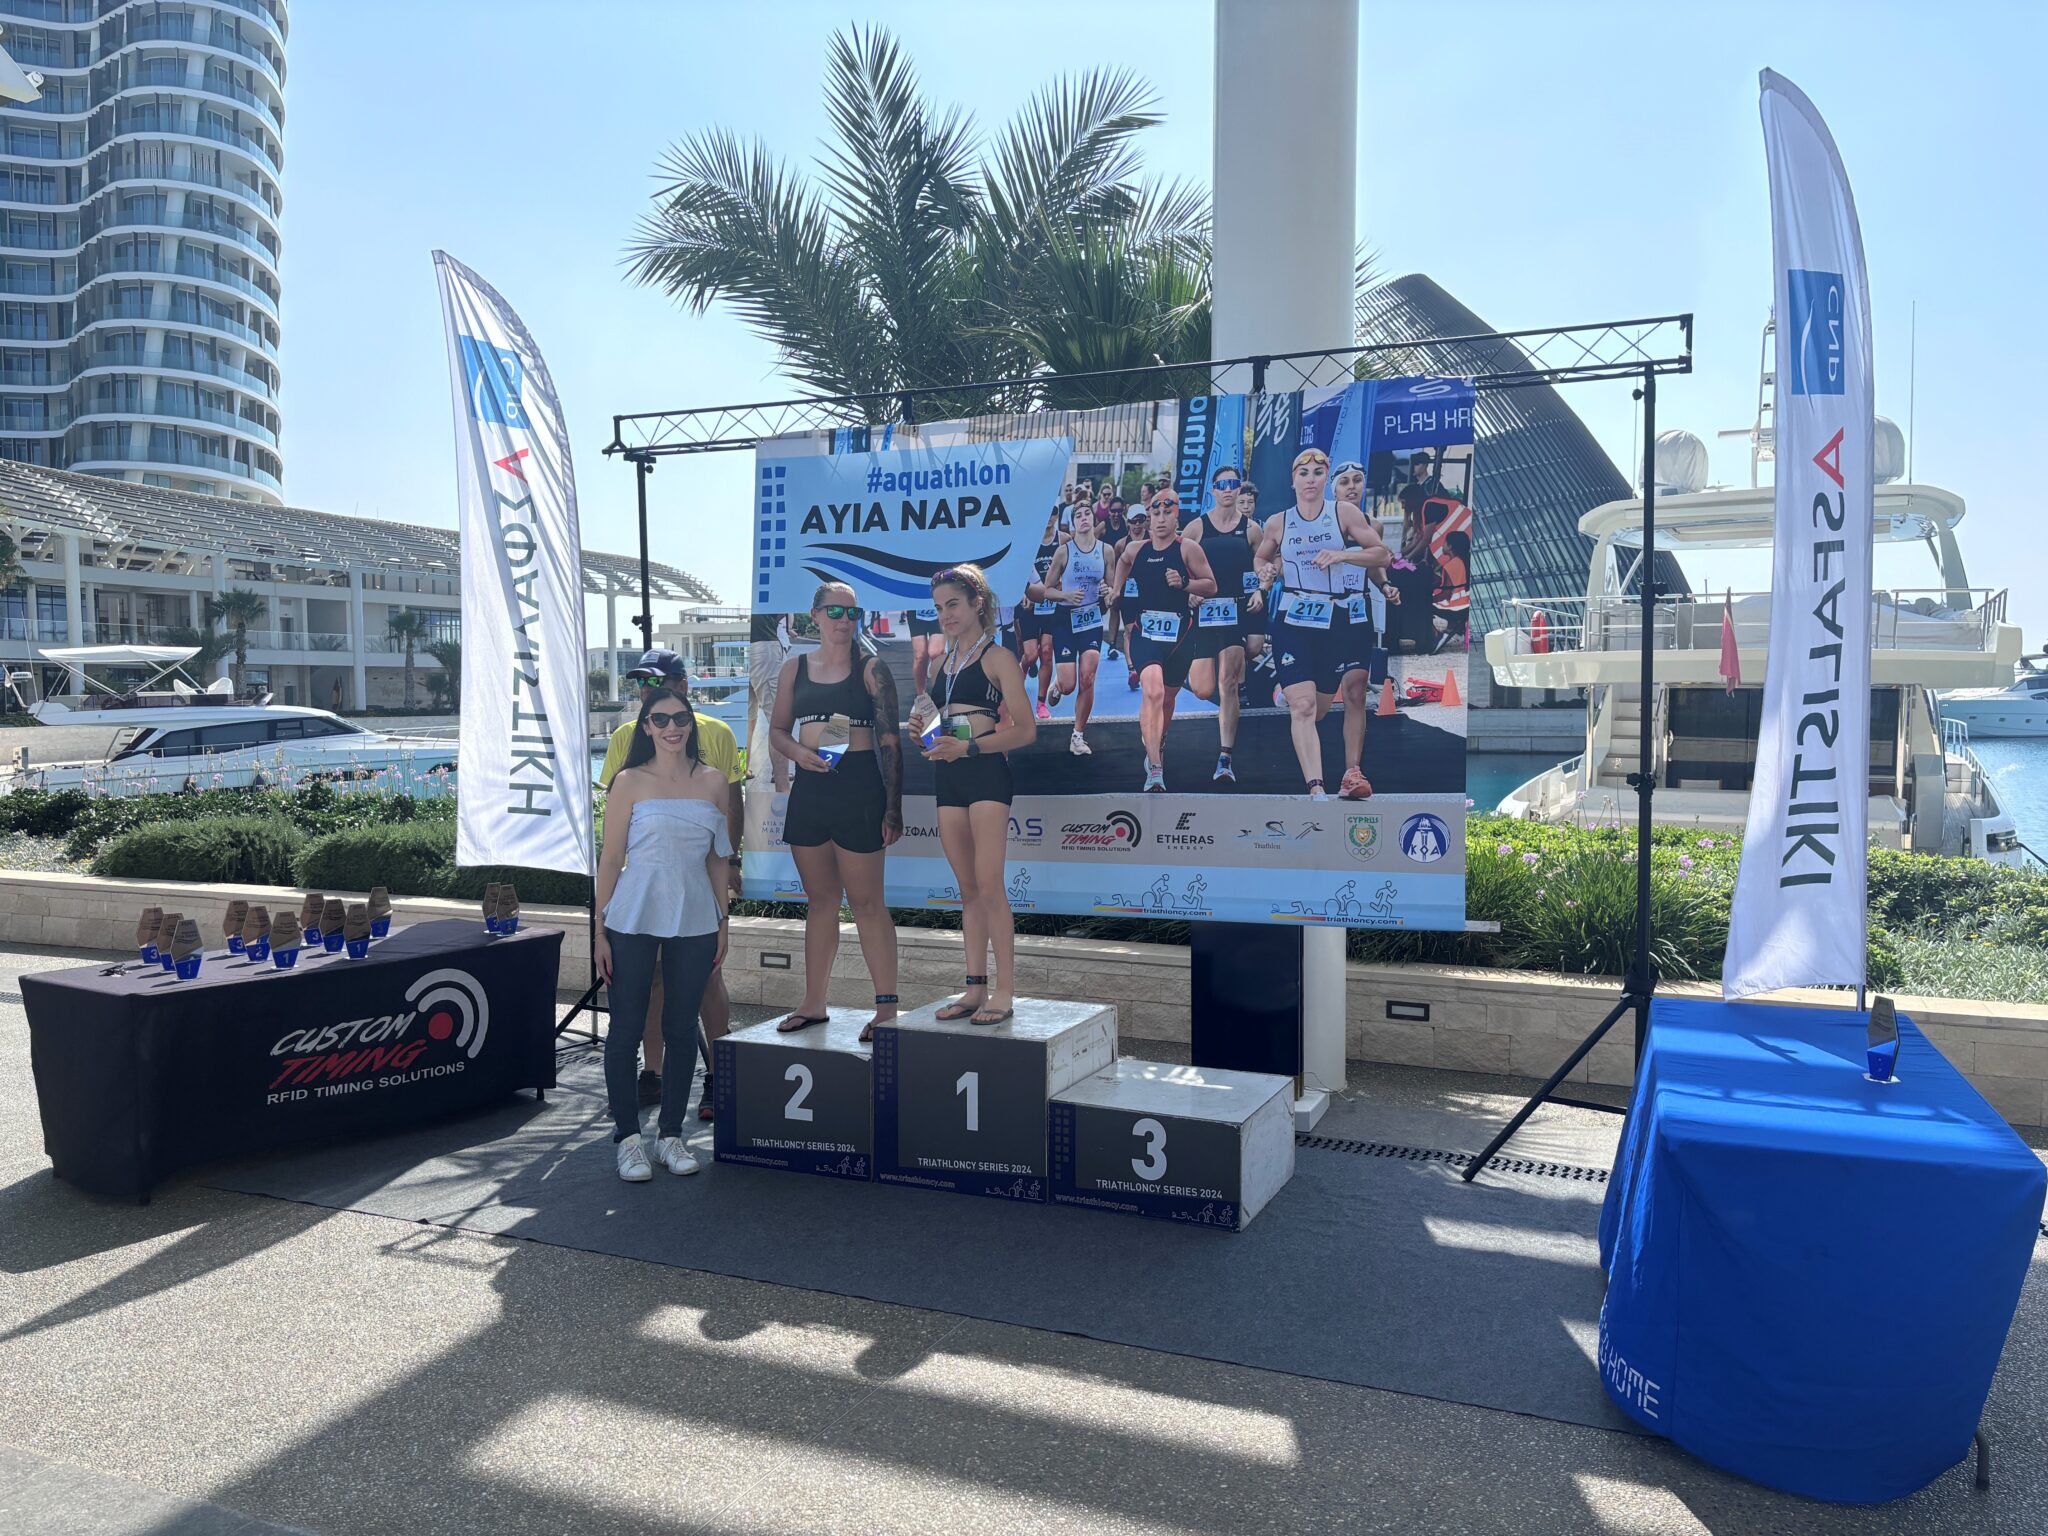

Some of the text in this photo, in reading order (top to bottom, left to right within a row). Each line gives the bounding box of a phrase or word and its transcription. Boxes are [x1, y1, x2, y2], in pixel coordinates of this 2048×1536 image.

[1384, 407, 1474, 436] PLAY HA
[867, 460, 1011, 497] #aquathlon
[800, 494, 1011, 535] AYIA NAPA
[1077, 611, 1095, 623] 209
[1206, 606, 1230, 617] 216
[1295, 602, 1324, 616] 217
[1147, 619, 1172, 632] 210
[1347, 816, 1379, 824] CYPRUS
[1061, 823, 1111, 834] CUSTOM
[1062, 834, 1116, 845] TIMING
[1156, 834, 1214, 845] ETHERAS
[1253, 842, 1281, 850] Triathlon
[1143, 908, 1207, 917] triathloncy.com
[1326, 916, 1398, 926] triathloncy.com
[270, 1011, 416, 1056] CUSTOM
[269, 1039, 427, 1089] TIMING
[267, 1061, 465, 1105] RFID TIMING SOLUTIONS
[784, 1063, 813, 1122] 2
[956, 1071, 979, 1132] 1
[752, 1138, 856, 1153] TRIATHLONCY SERIES 2024
[1131, 1117, 1167, 1181] 3
[720, 1153, 789, 1167] www.triathloncy.com
[917, 1157, 1032, 1174] TRIATHLONCY SERIES 2024
[879, 1172, 956, 1189] www.triathloncy.com
[1096, 1179, 1223, 1199] TRIATHLONCY SERIES 2024
[1055, 1193, 1139, 1212] www.triathloncy.com
